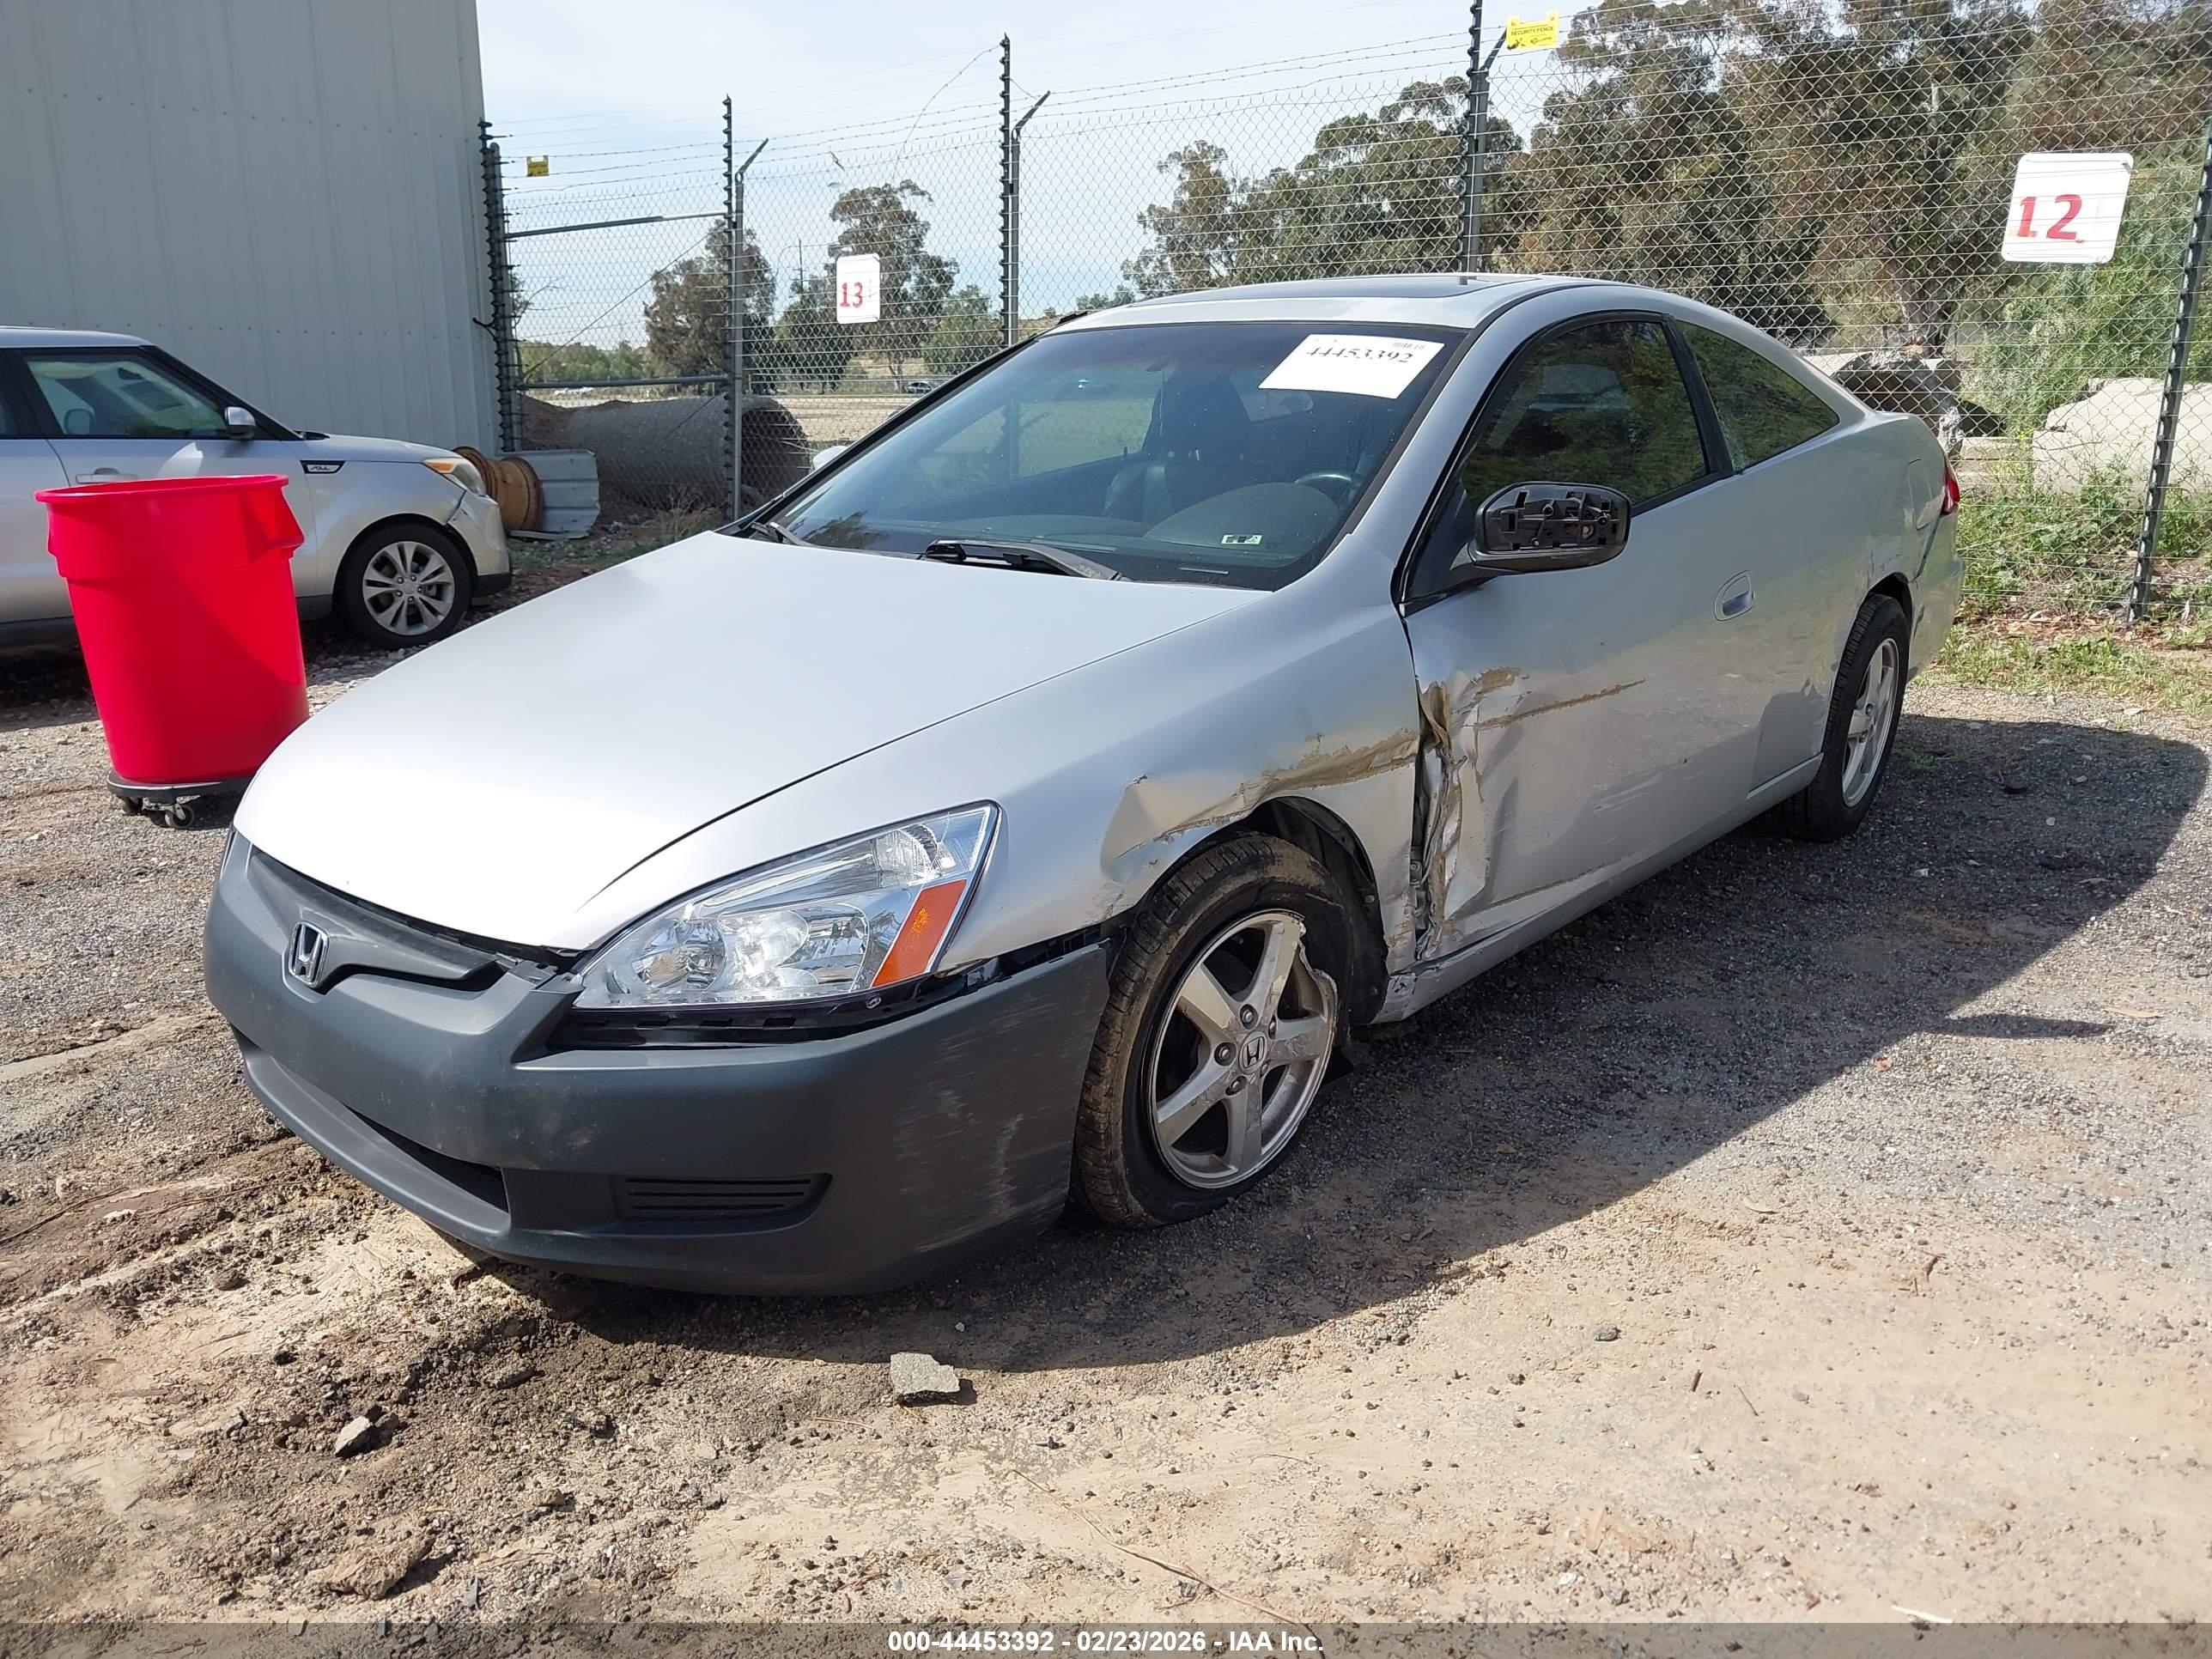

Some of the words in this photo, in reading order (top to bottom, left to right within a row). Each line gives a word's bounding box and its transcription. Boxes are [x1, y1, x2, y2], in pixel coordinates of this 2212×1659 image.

[2019, 193, 2083, 240] 12
[840, 282, 864, 308] 13
[1305, 346, 1414, 363] 44453392
